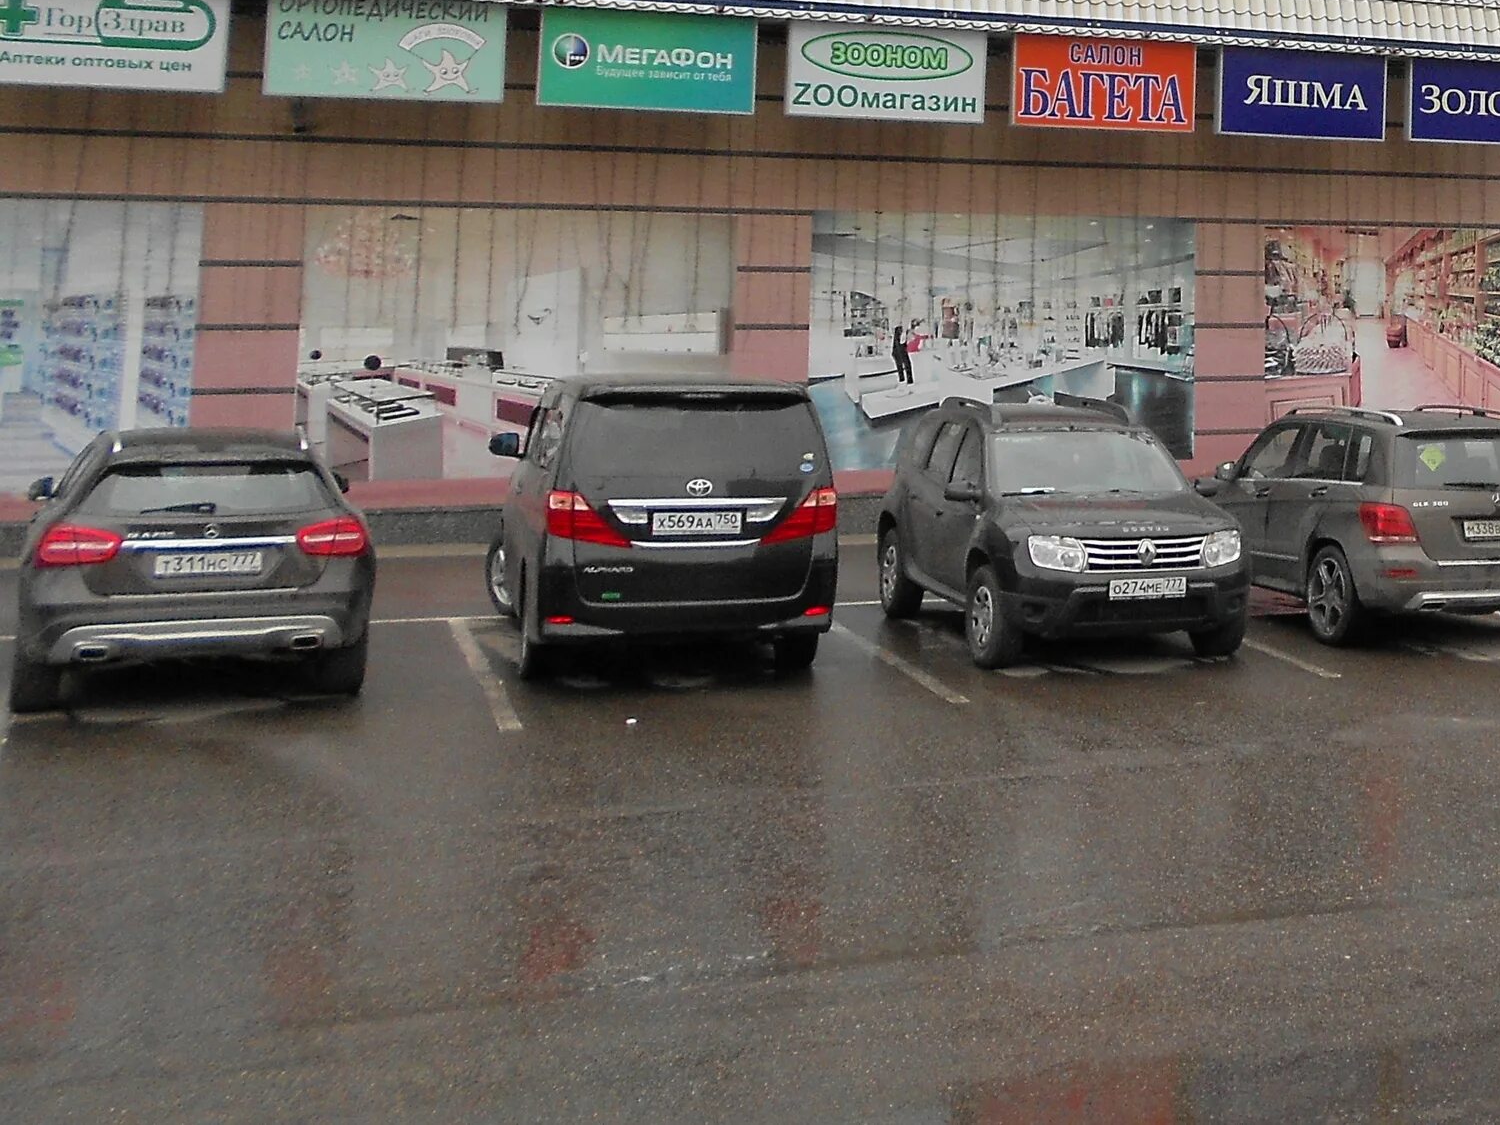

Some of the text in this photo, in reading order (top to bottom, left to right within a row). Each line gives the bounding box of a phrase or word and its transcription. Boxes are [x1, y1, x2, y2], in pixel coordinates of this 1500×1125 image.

[277, 20, 355, 43] САЛОН
[0, 50, 192, 72] Аптеки оптовых цен
[829, 40, 949, 72] ЗООНОМ
[1069, 42, 1144, 67] САЛОН
[648, 69, 690, 80] зависит
[693, 72, 705, 80] от
[707, 71, 732, 82] тебя
[791, 82, 978, 114] ZOOмагазин
[1018, 66, 1188, 124] БАГЕТА
[1244, 74, 1369, 112] ЯШМА
